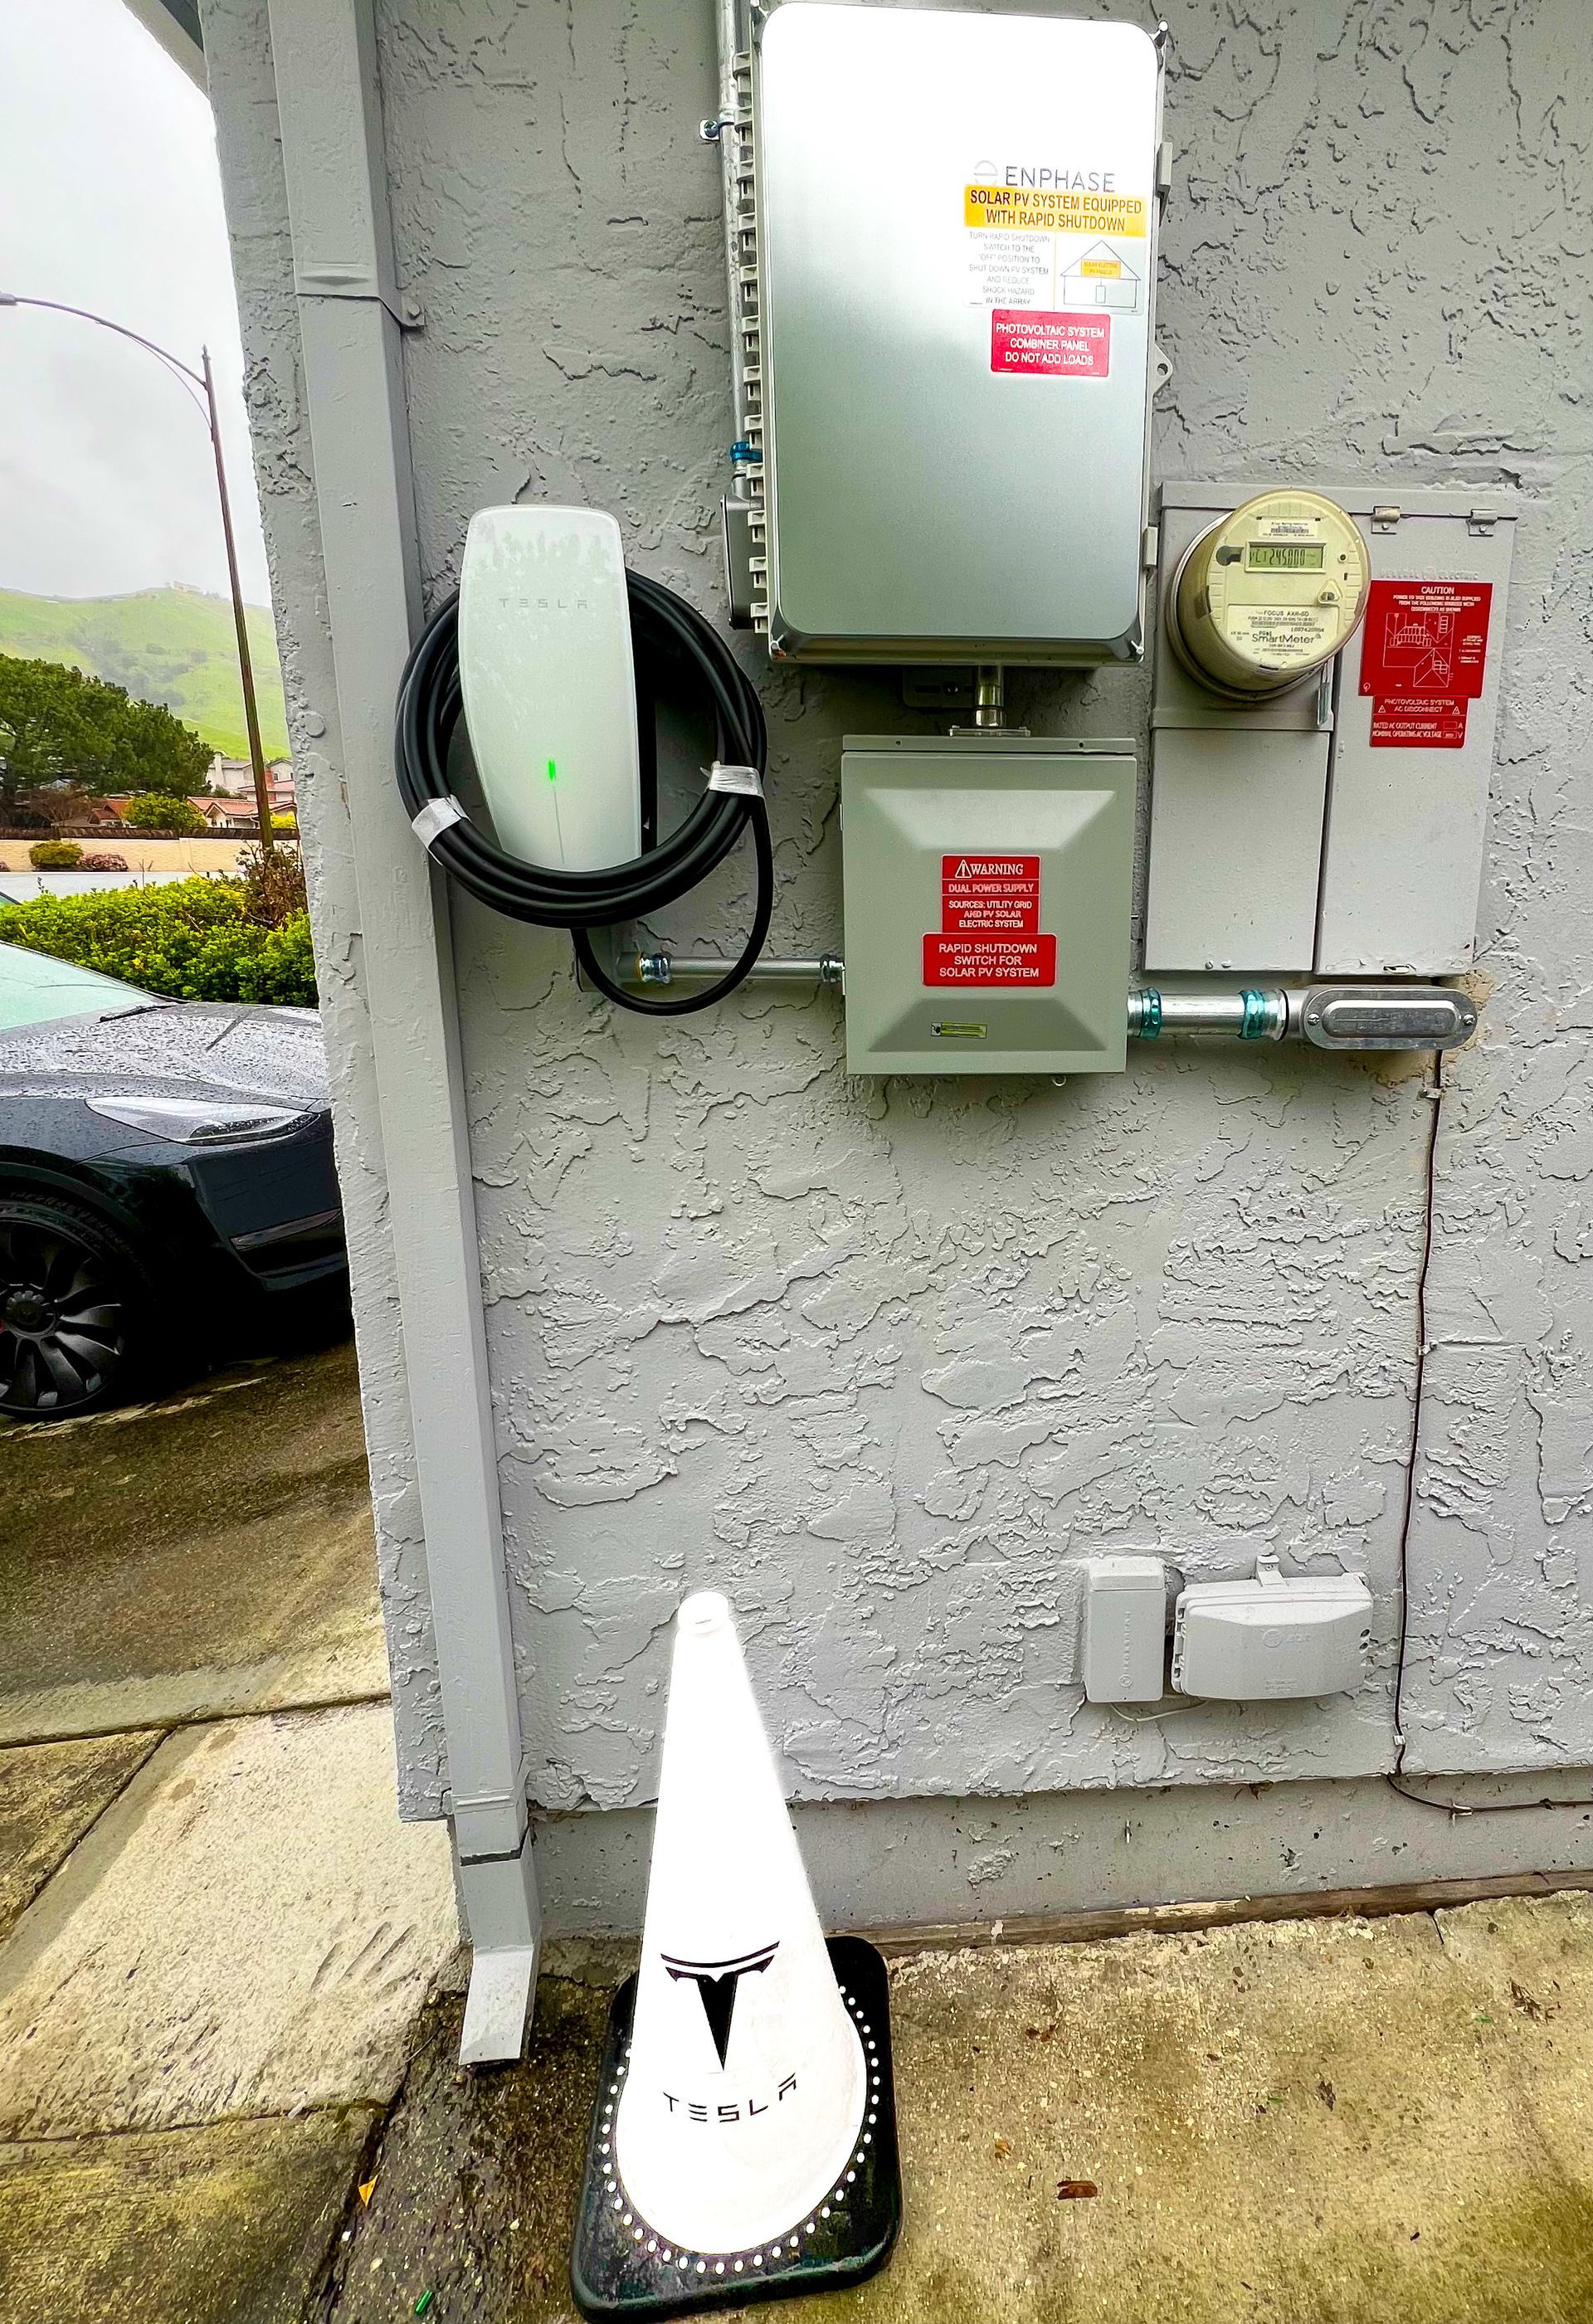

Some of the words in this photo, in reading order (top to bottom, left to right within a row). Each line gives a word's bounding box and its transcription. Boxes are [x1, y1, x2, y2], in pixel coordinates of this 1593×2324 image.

[1006, 166, 1115, 192] ENPHASE
[970, 190, 1010, 205] SOLAR
[1014, 192, 1030, 207] PV
[1033, 194, 1079, 210] SYSTEM
[1084, 197, 1142, 214] EQUIPPED
[986, 209, 1016, 224] WITH
[1019, 212, 1055, 227] RAPID
[1058, 214, 1125, 231] SHUTDOWN
[989, 232, 1010, 241] RAPID
[1011, 234, 1050, 242] SHUTDOWN
[983, 243, 1010, 251] SWITCH
[1011, 244, 1021, 252] TO
[1022, 245, 1035, 253] THE
[997, 255, 1030, 263] POSITION
[969, 264, 986, 272] SHUT
[1022, 266, 1049, 275] SYSTEM
[1003, 276, 1030, 285] REDUCE
[982, 285, 1006, 294] SHOCK
[1007, 287, 1035, 295] HAZARD
[996, 323, 1065, 337] PHOTOVOLTAIC
[1067, 325, 1104, 339] SYSTEM
[1010, 338, 1060, 350] COMBINER
[1060, 340, 1089, 352] PANEL
[1005, 351, 1020, 363] DO
[1021, 353, 1040, 363] NOT
[1041, 353, 1061, 364] ADD
[1064, 354, 1094, 366] LOADS
[1421, 587, 1454, 595] CAUTION
[499, 598, 587, 609] TESLA
[1251, 633, 1315, 644] SmartMeter
[970, 863, 1023, 875] WARNING
[948, 884, 971, 893] DUAL
[972, 884, 1002, 893] POWER
[1003, 884, 1034, 893] SUPPLY
[995, 910, 1021, 918] SOLAR
[939, 943, 972, 953] RAPID
[974, 943, 1037, 953] SHUTDOWN
[954, 956, 996, 966] SWITCH
[999, 956, 1022, 966] FOR
[939, 967, 976, 977] SOLAR
[978, 967, 993, 977] PV
[995, 967, 1039, 977] SYSTEM
[663, 2073, 796, 2123] TESLA
